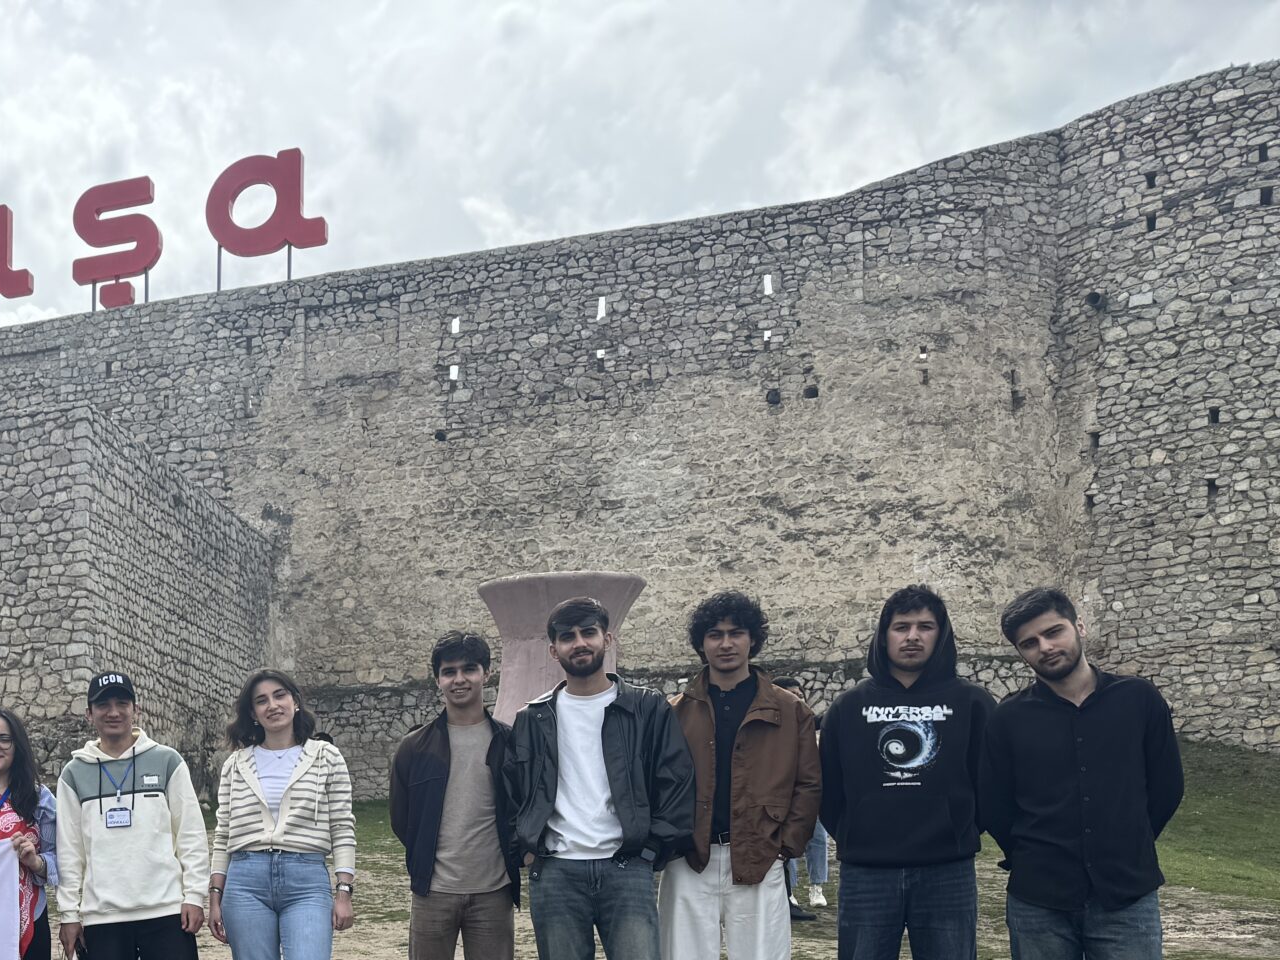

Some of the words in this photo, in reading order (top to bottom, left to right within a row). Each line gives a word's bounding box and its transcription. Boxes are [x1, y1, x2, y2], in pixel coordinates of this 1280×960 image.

[98, 674, 124, 687] ICON
[862, 704, 954, 716] UNIVERSAL
[866, 712, 947, 724] BALANCE
